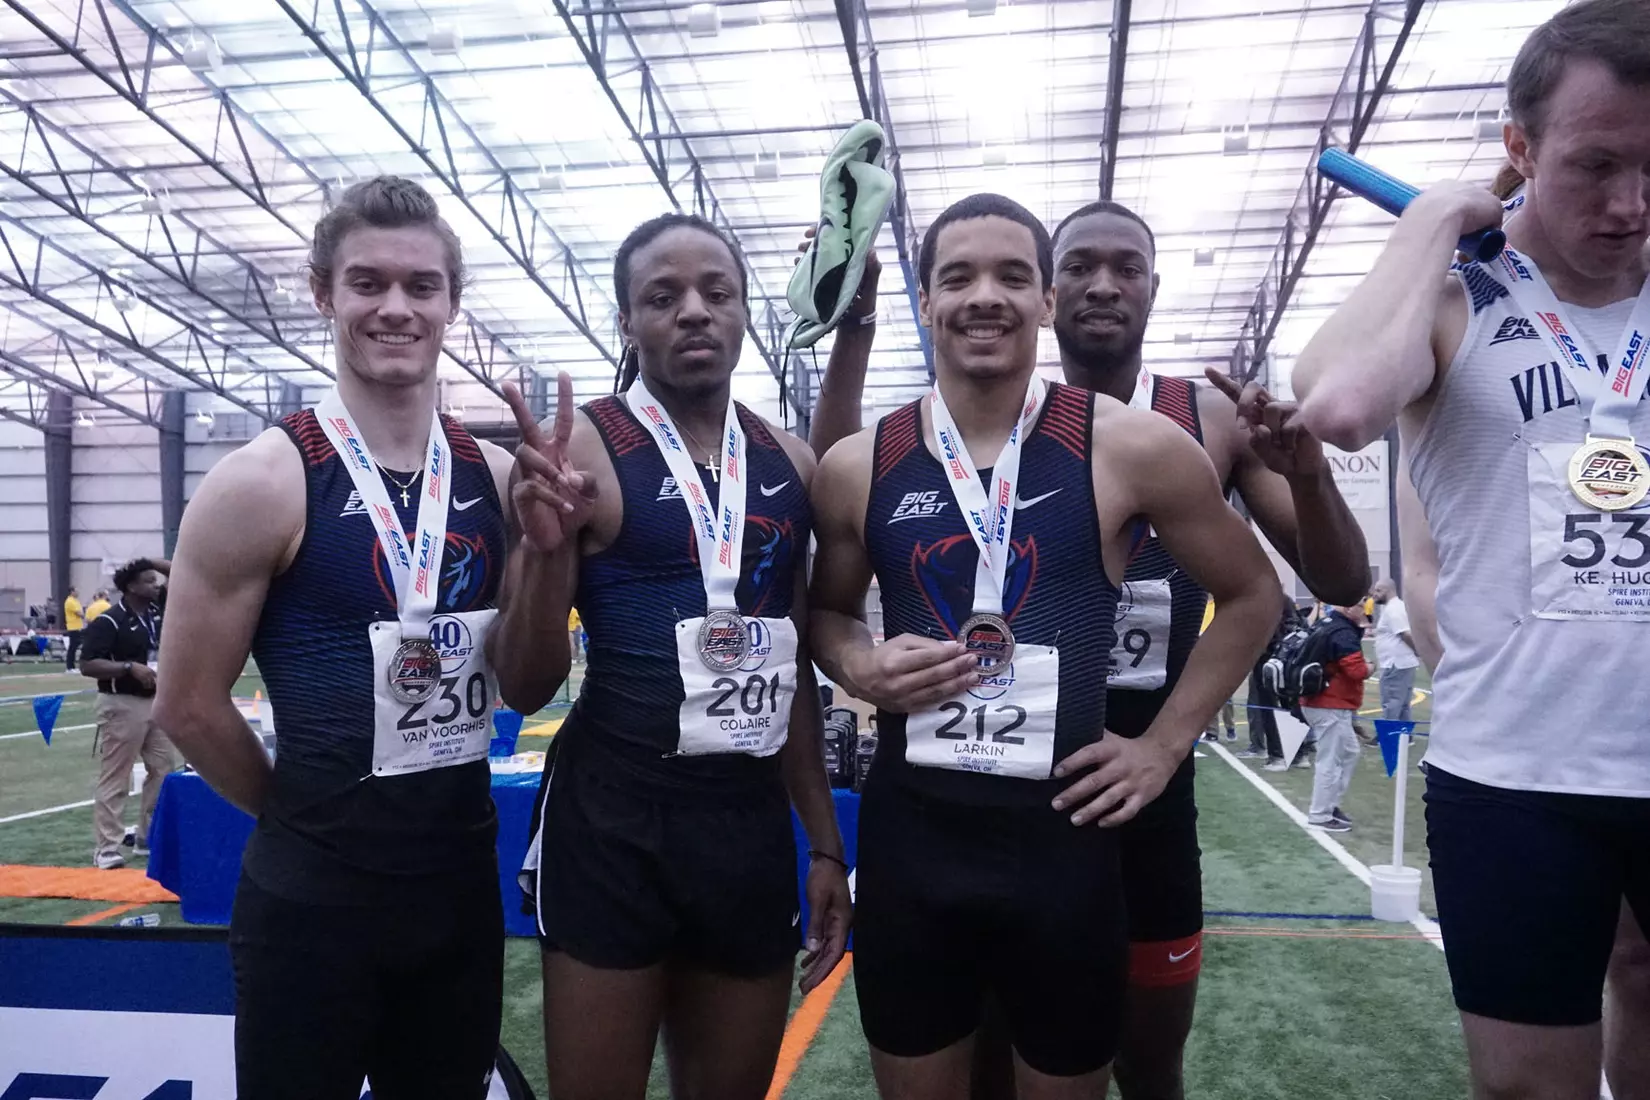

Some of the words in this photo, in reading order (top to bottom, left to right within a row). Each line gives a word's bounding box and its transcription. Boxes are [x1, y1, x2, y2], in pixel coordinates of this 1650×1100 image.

[1505, 250, 1534, 281] EAST
[1493, 328, 1540, 340] EAS
[1544, 312, 1568, 335] BIG
[1559, 334, 1591, 371] EAST
[1612, 366, 1630, 393] BIG
[1621, 329, 1643, 370] EAST
[646, 405, 665, 423] BIG
[658, 423, 682, 453] EAST
[728, 426, 737, 458] EAST
[335, 418, 354, 438] BIG
[346, 437, 372, 472] EAST
[431, 439, 441, 477] EAST
[938, 430, 955, 460] EAST
[727, 456, 735, 478] BIG
[949, 460, 964, 480] BIG
[1328, 455, 1381, 473] NON
[1581, 468, 1642, 482] EAST
[1588, 458, 1632, 471] BIG
[428, 472, 439, 498] BIG
[900, 490, 941, 505] BIG
[1001, 480, 1010, 507] BIG
[690, 482, 705, 505] BIG
[699, 503, 716, 542] EAST
[892, 502, 949, 517] EAST
[722, 505, 732, 543] EAST
[996, 505, 1008, 545] EAST
[380, 505, 398, 531] BIG
[390, 529, 411, 571] EAST
[419, 528, 431, 570] EAST
[1560, 513, 1650, 568] 53
[719, 540, 729, 565] BIG
[415, 567, 426, 594] BIG
[1573, 571, 1605, 585] KE.
[1608, 587, 1628, 596] SPIRE
[429, 621, 461, 650] 40
[706, 637, 746, 647] EAST
[711, 627, 740, 638] BIG
[747, 621, 762, 647] 0
[440, 647, 474, 658] EAST
[966, 641, 1010, 651] EAST
[706, 672, 780, 717] 201
[980, 677, 1016, 686] EAST
[396, 672, 487, 731] 230
[402, 730, 428, 743] VAN
[431, 719, 486, 738] VOORHIS
[720, 717, 771, 731] COLAIRE
[935, 701, 1027, 746] 212
[954, 743, 1005, 756] LARKIN
